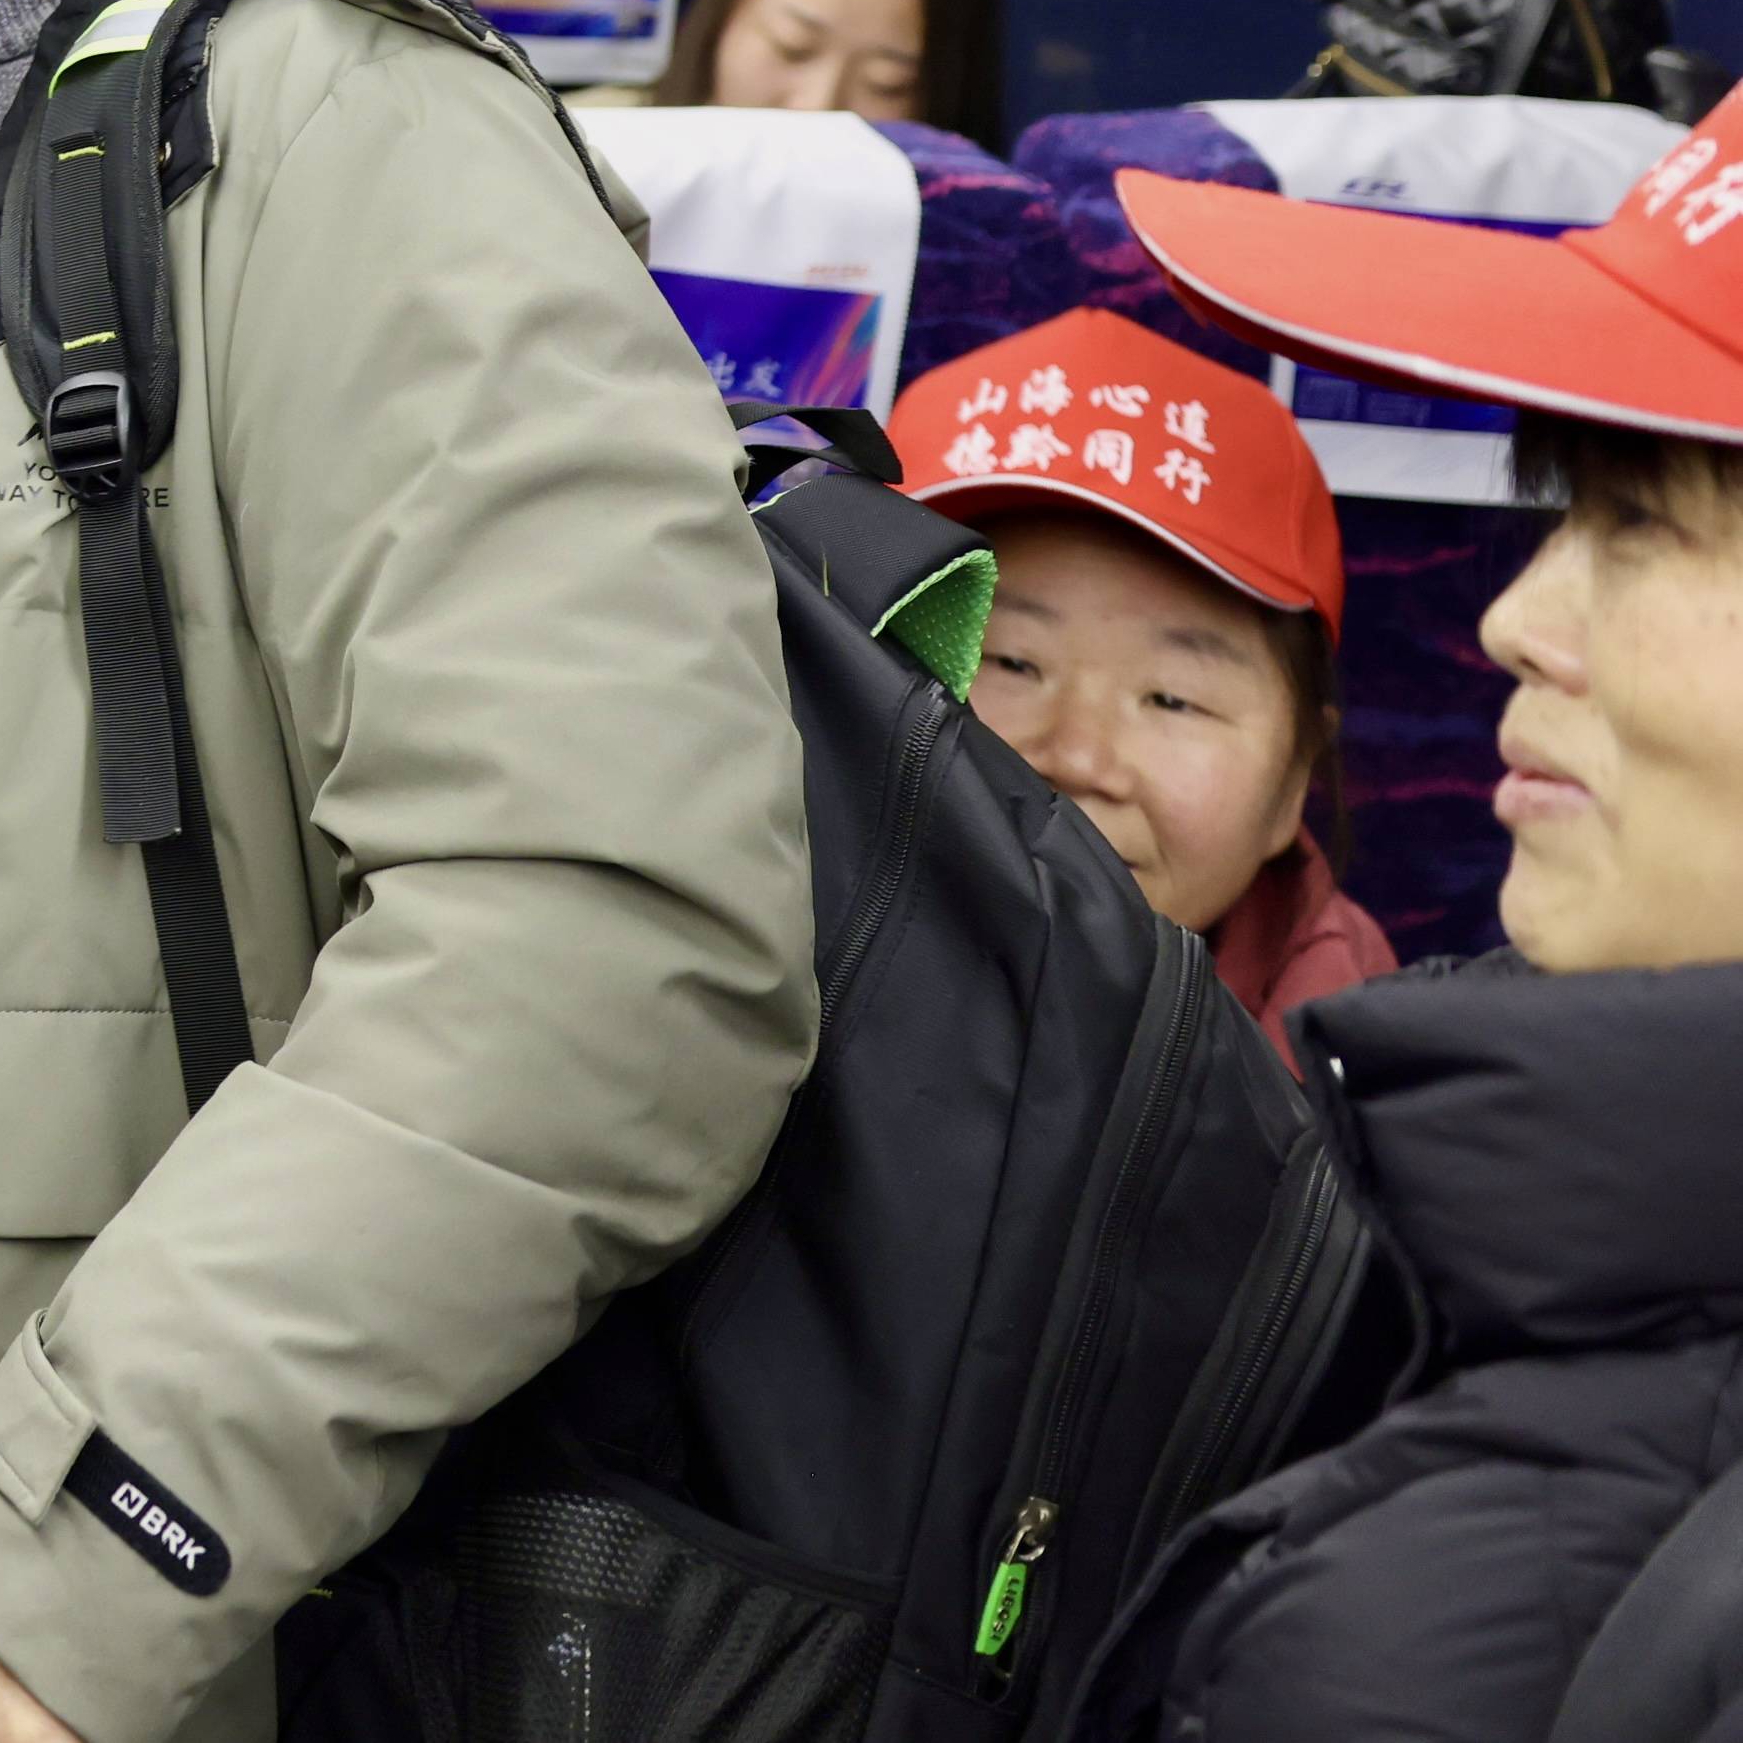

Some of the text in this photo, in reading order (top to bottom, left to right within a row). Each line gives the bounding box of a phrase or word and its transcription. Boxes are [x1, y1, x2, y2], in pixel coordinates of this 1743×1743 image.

[956, 363, 1216, 455] 山海心连
[139, 1504, 207, 1571] BRK
